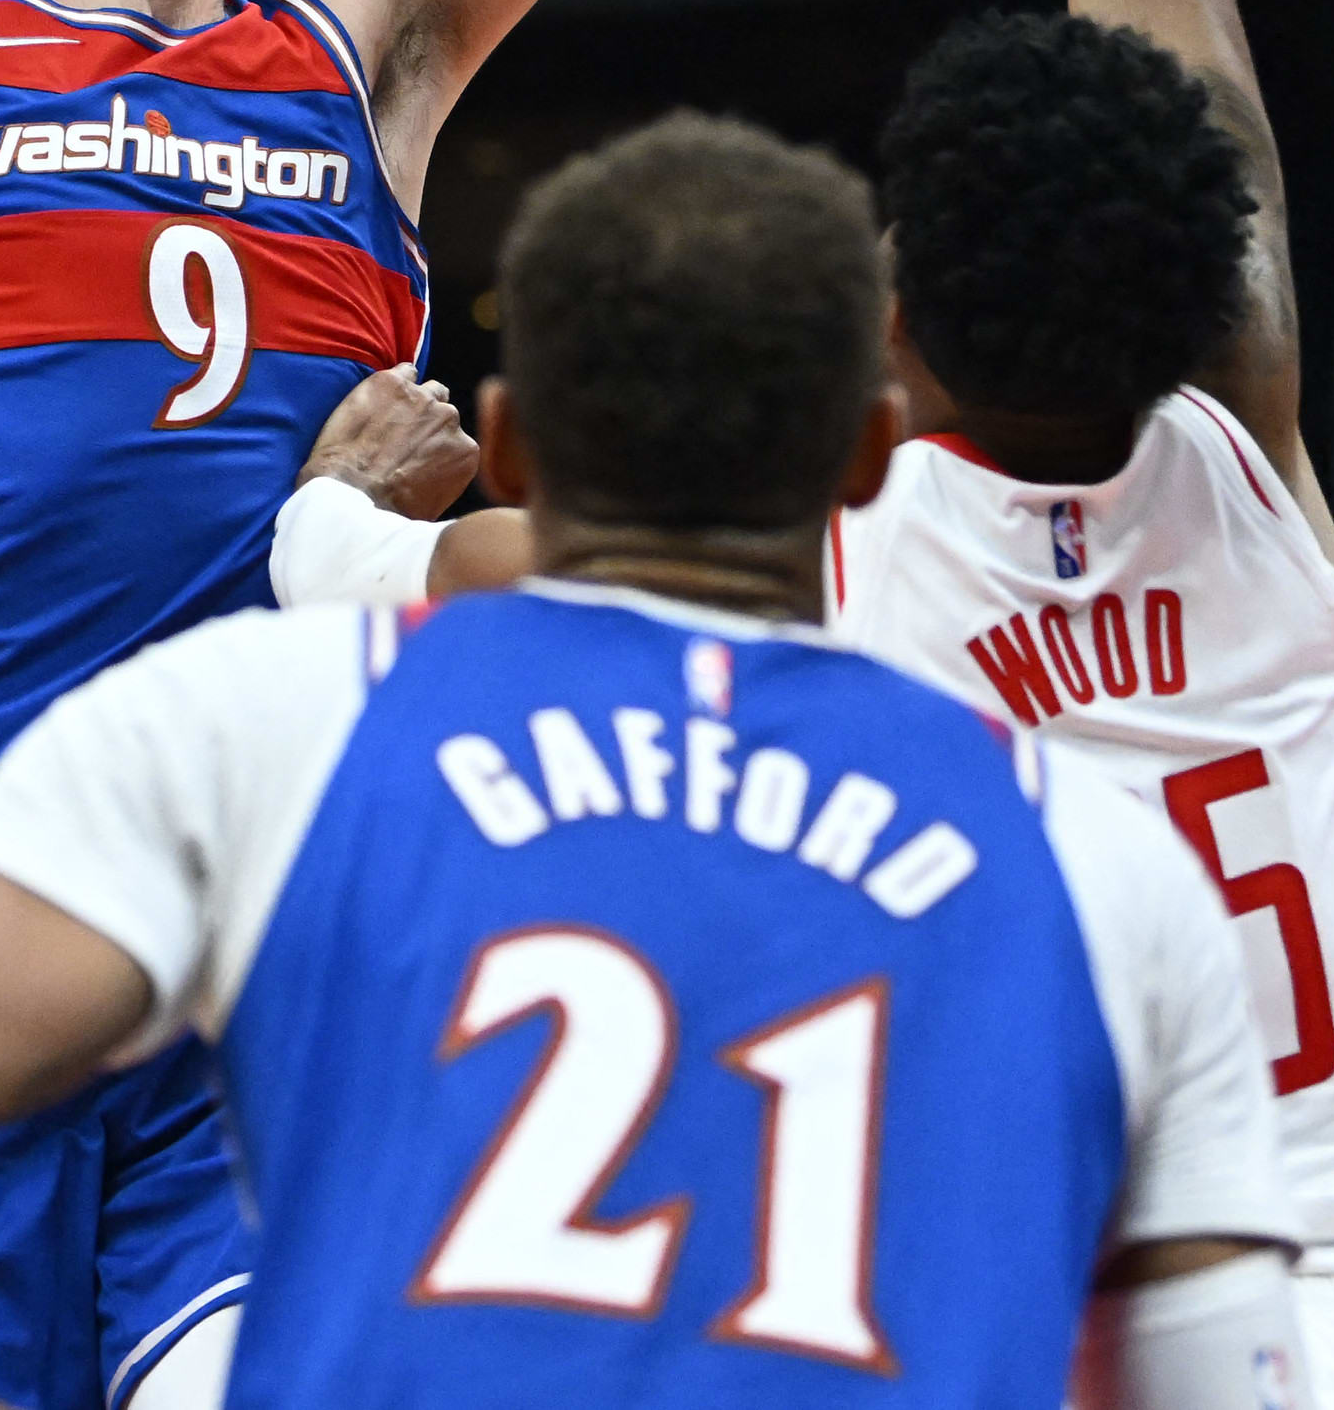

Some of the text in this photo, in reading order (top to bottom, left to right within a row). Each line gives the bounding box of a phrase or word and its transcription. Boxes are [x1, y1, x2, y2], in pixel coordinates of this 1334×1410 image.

[140, 216, 254, 430] 9
[966, 588, 1187, 727] WOOD
[436, 705, 979, 920] GAFFORD
[405, 921, 903, 1379] 21
